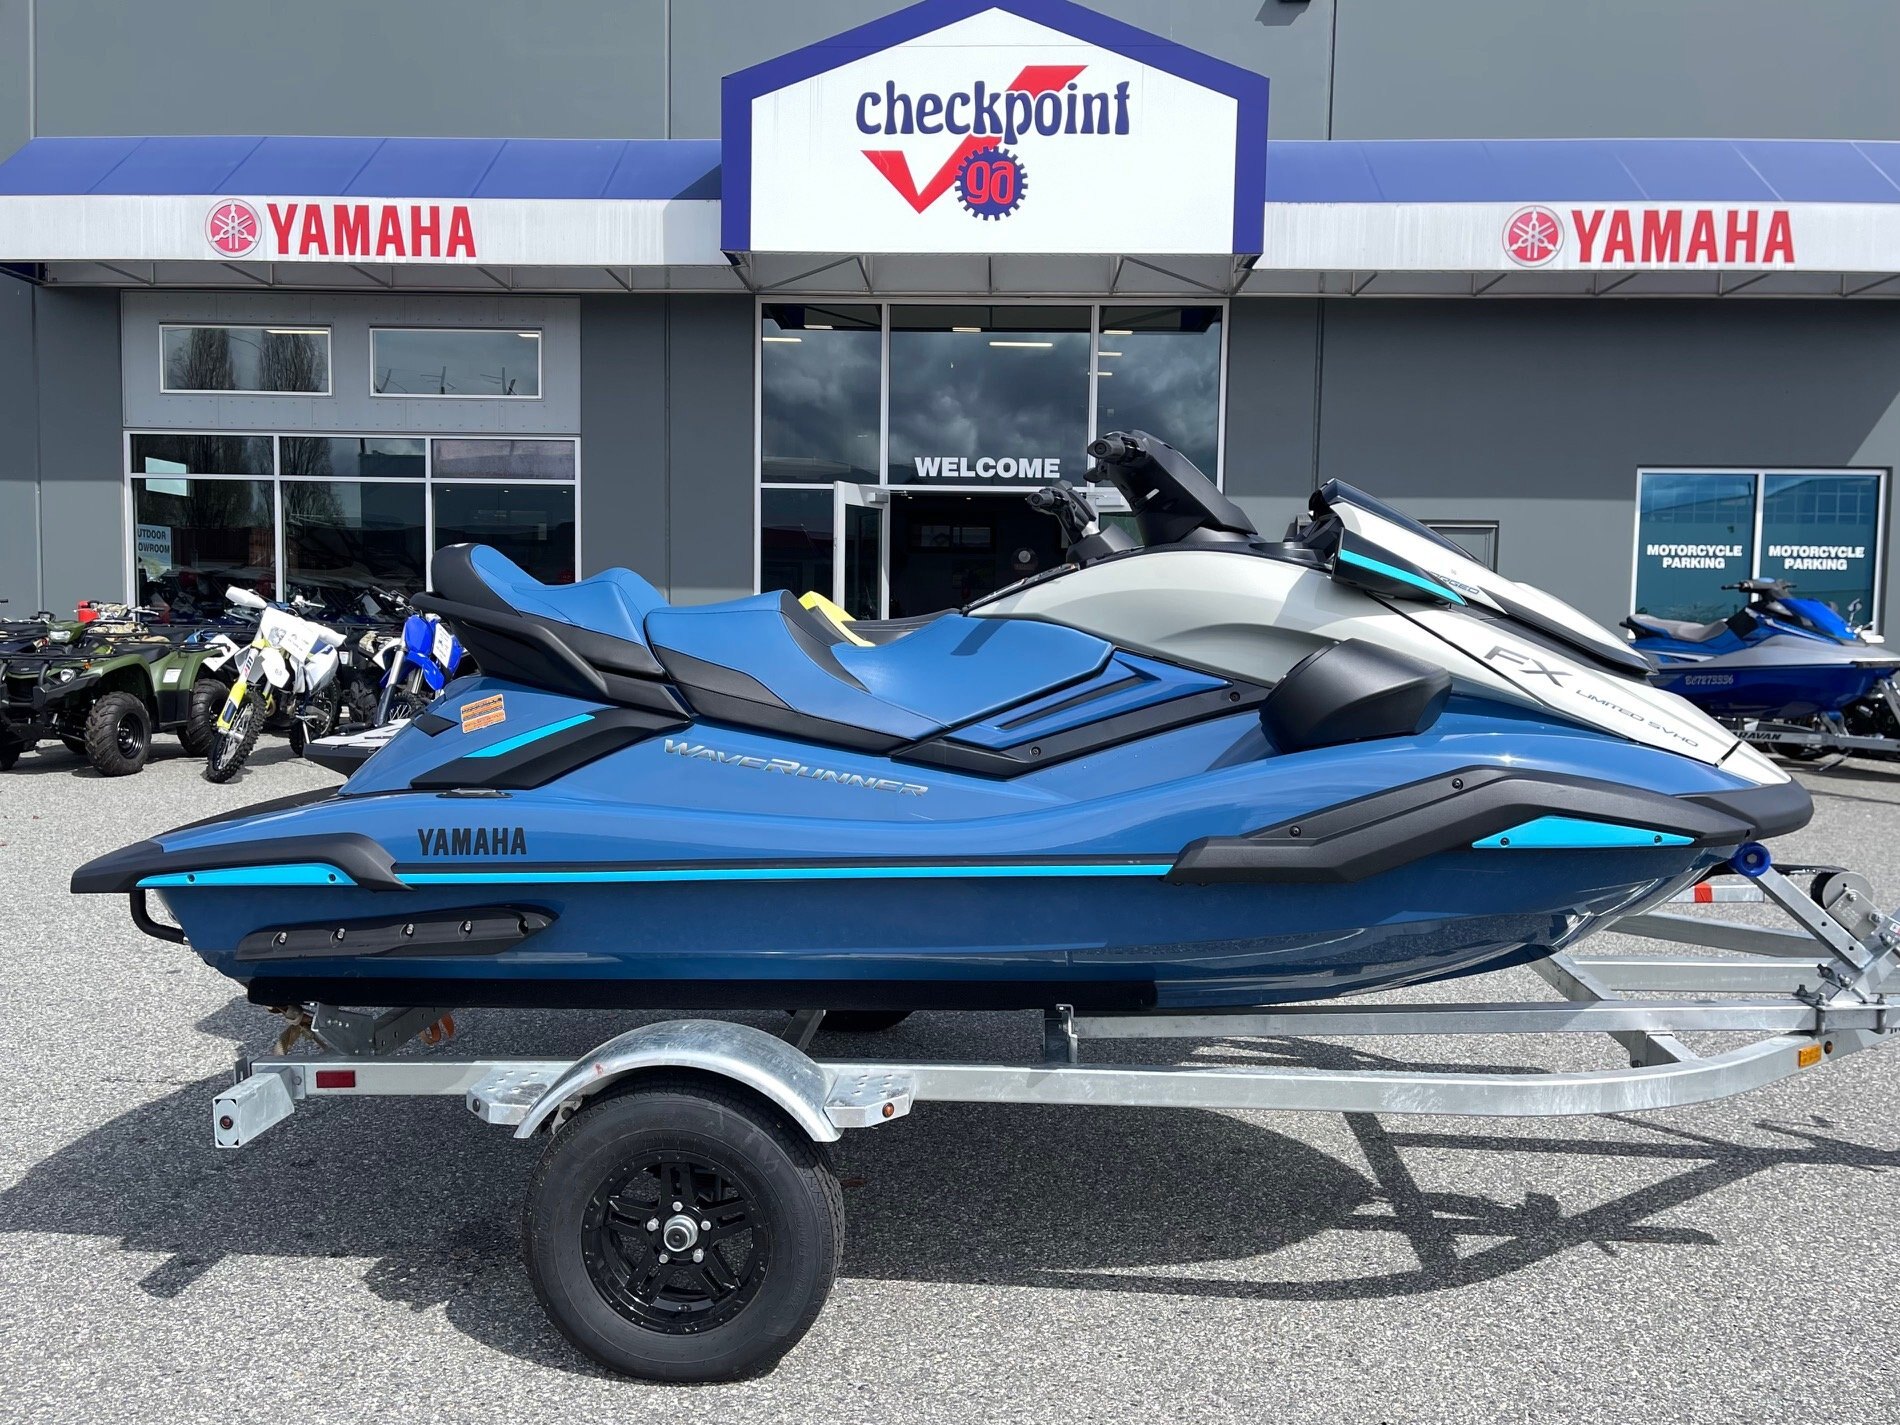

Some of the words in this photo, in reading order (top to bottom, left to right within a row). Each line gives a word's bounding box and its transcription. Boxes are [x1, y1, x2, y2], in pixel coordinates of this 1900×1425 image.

[856, 80, 1130, 145] checkpoint
[267, 203, 476, 257] YAMAHA
[1571, 209, 1795, 263] YAMAHA
[914, 457, 1060, 478] WELCOME
[1646, 544, 1742, 557] MOTORCYCLE
[1662, 557, 1725, 569] PARKING
[1768, 545, 1865, 558] MOTORCYCLE
[1784, 558, 1847, 570] PARKING
[1484, 646, 1573, 688] FX
[1576, 690, 1644, 721] LIMITED
[1648, 721, 1699, 747] SVHO
[418, 827, 526, 856] YAMAHA
